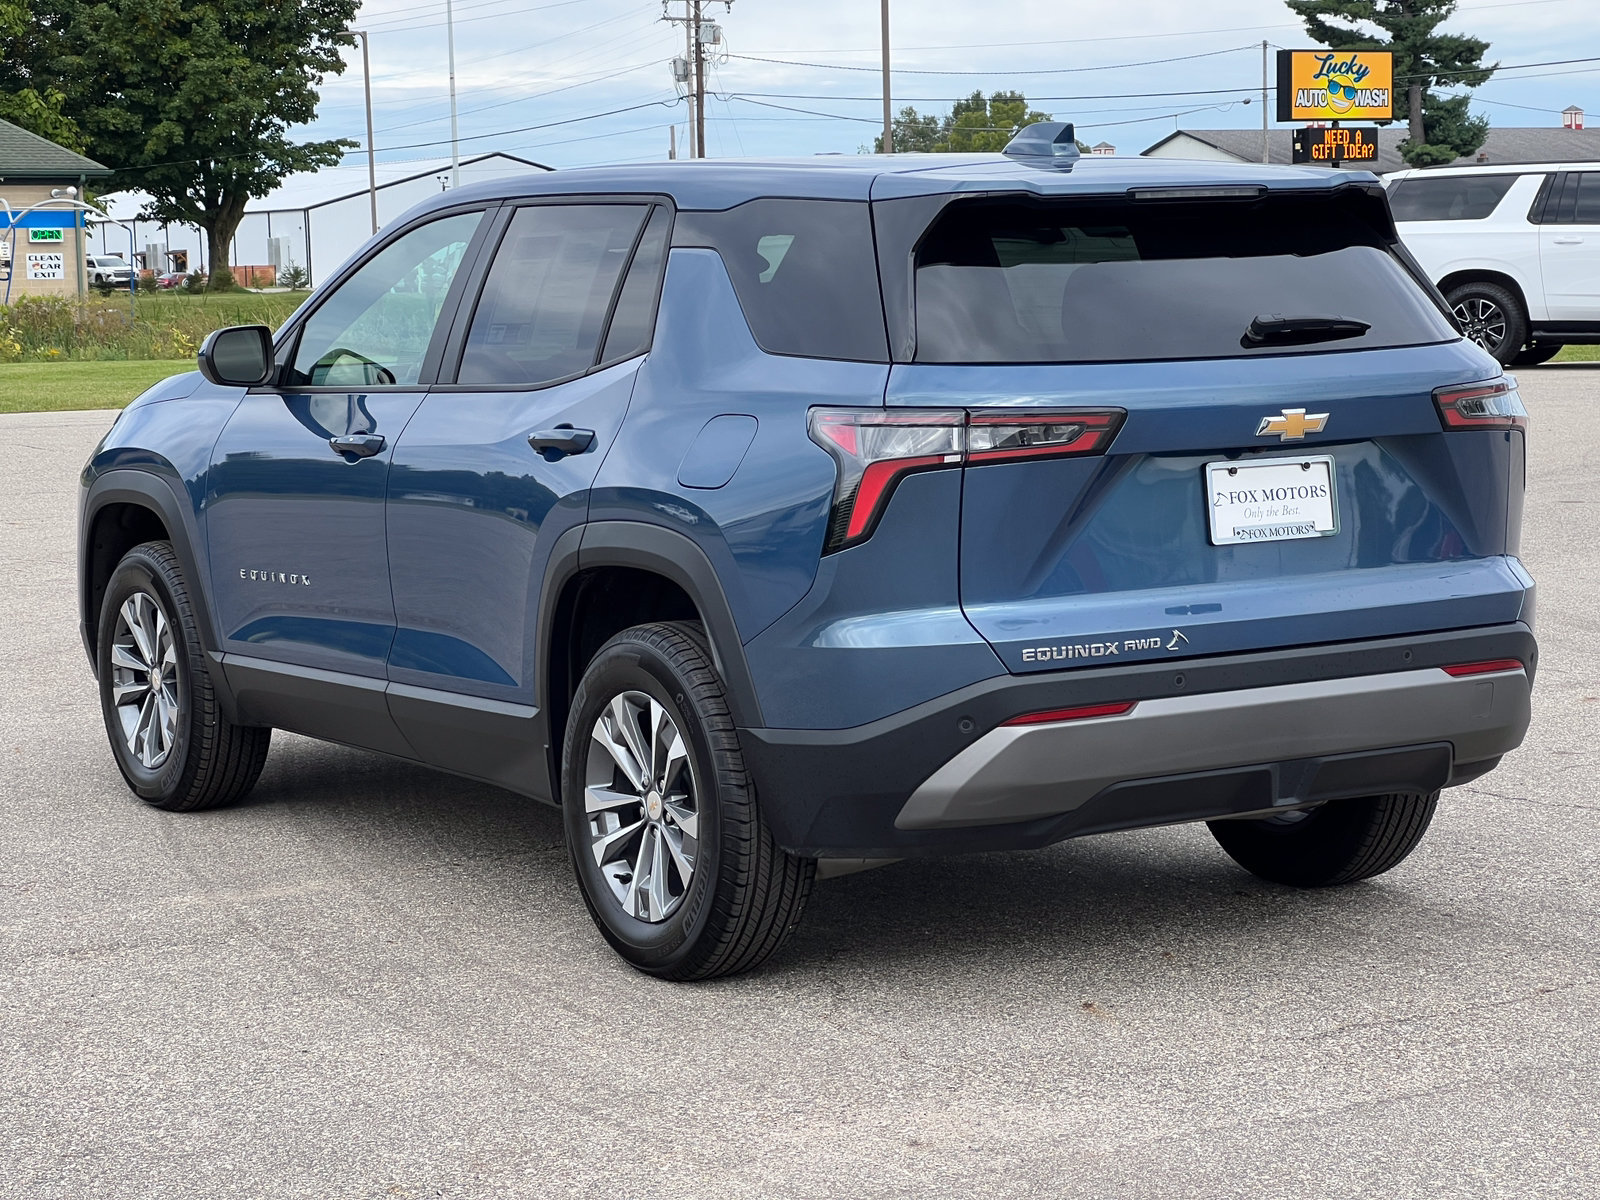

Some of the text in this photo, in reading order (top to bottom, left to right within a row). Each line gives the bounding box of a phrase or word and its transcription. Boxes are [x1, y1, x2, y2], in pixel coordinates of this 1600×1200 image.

[1313, 54, 1370, 82] Lucky
[1295, 88, 1389, 107] AUTO WASH
[1324, 130, 1362, 144] NEED A
[1312, 144, 1374, 159] GIFT IDEA?
[31, 230, 62, 240] OPEN
[1229, 484, 1327, 504] FOX MOTORS
[1244, 506, 1263, 521] Only
[1266, 505, 1279, 517] the
[1249, 524, 1310, 539] FOX MOTORS
[240, 568, 311, 586] EQUINOX
[1022, 637, 1161, 661] EQUINOX AWD
